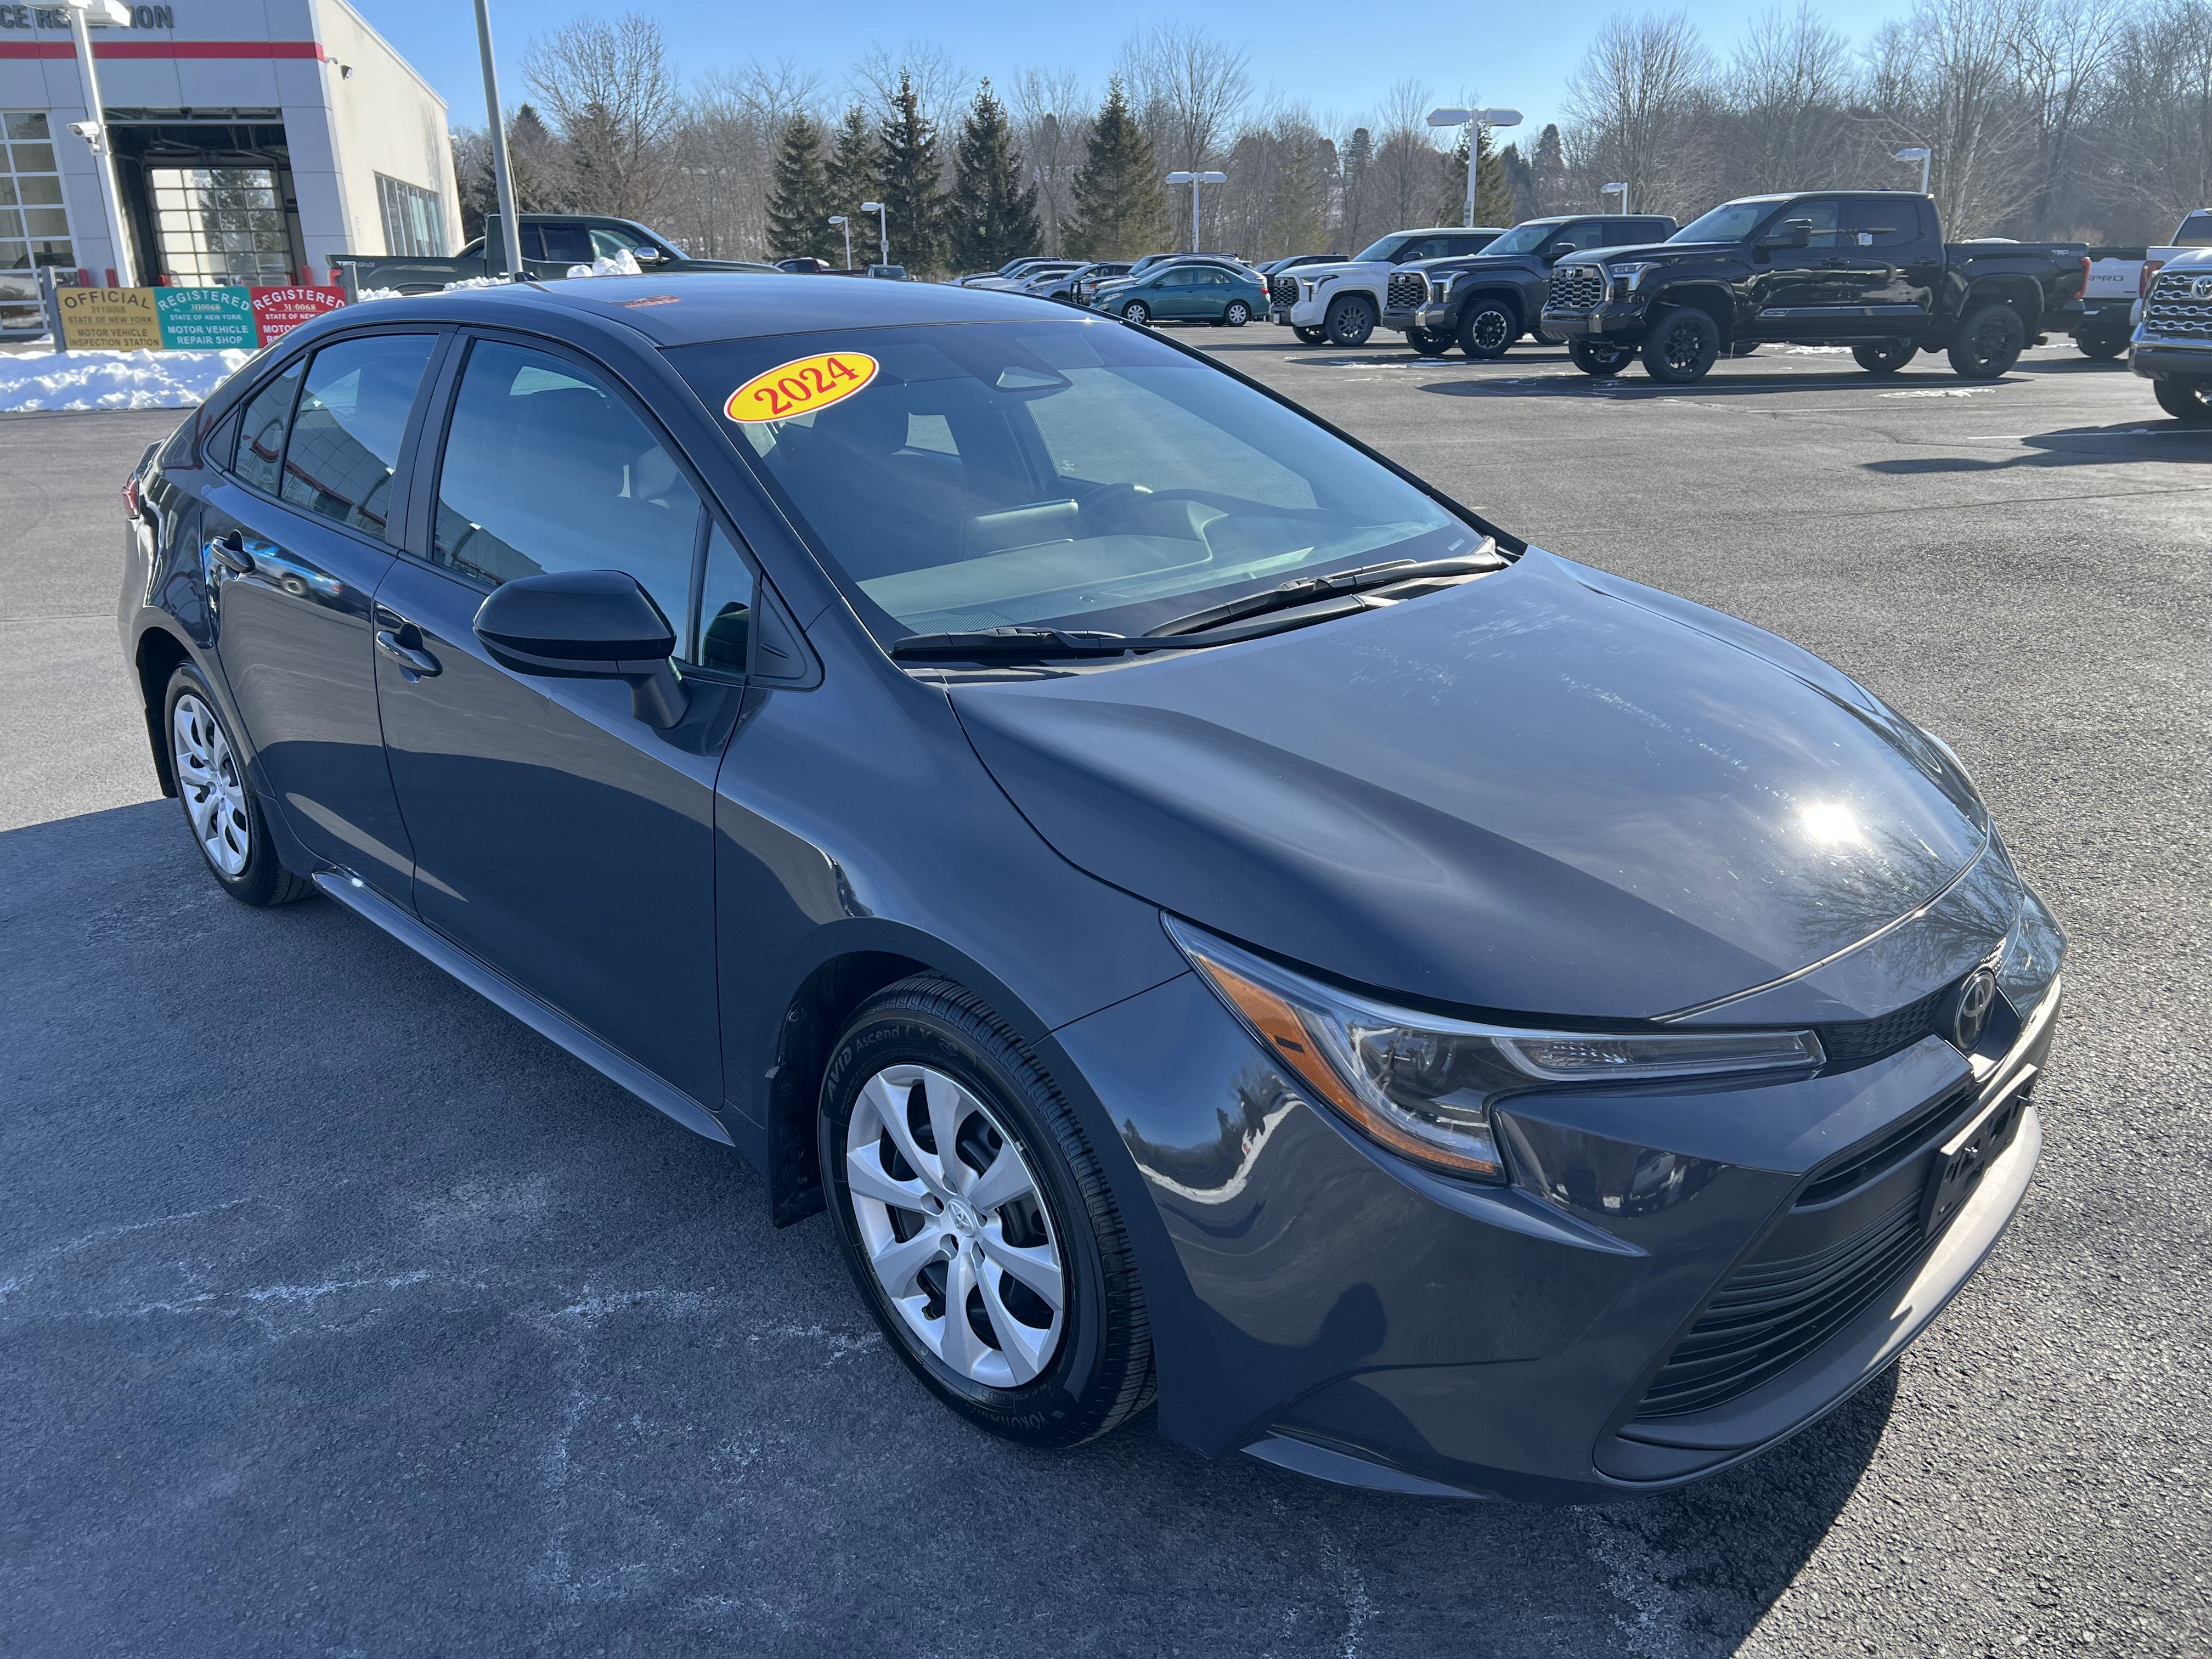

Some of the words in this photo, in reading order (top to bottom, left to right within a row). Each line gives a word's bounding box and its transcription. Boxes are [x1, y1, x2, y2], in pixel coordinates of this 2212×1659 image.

[35, 5, 173, 29] REION
[65, 291, 150, 309] OFFICIAL
[157, 290, 250, 311] REGISTERED
[253, 289, 345, 311] REGISTERED
[111, 329, 148, 337] VEHICLE
[168, 325, 204, 334] MOTOR
[205, 325, 249, 334] VEHICLE
[70, 338, 121, 347] INSPECTION
[177, 336, 213, 345] REPAIR
[216, 336, 242, 344] SHOP
[754, 358, 860, 415] 2024
[827, 1046, 851, 1102] AVID
[856, 1025, 900, 1053] Ascend
